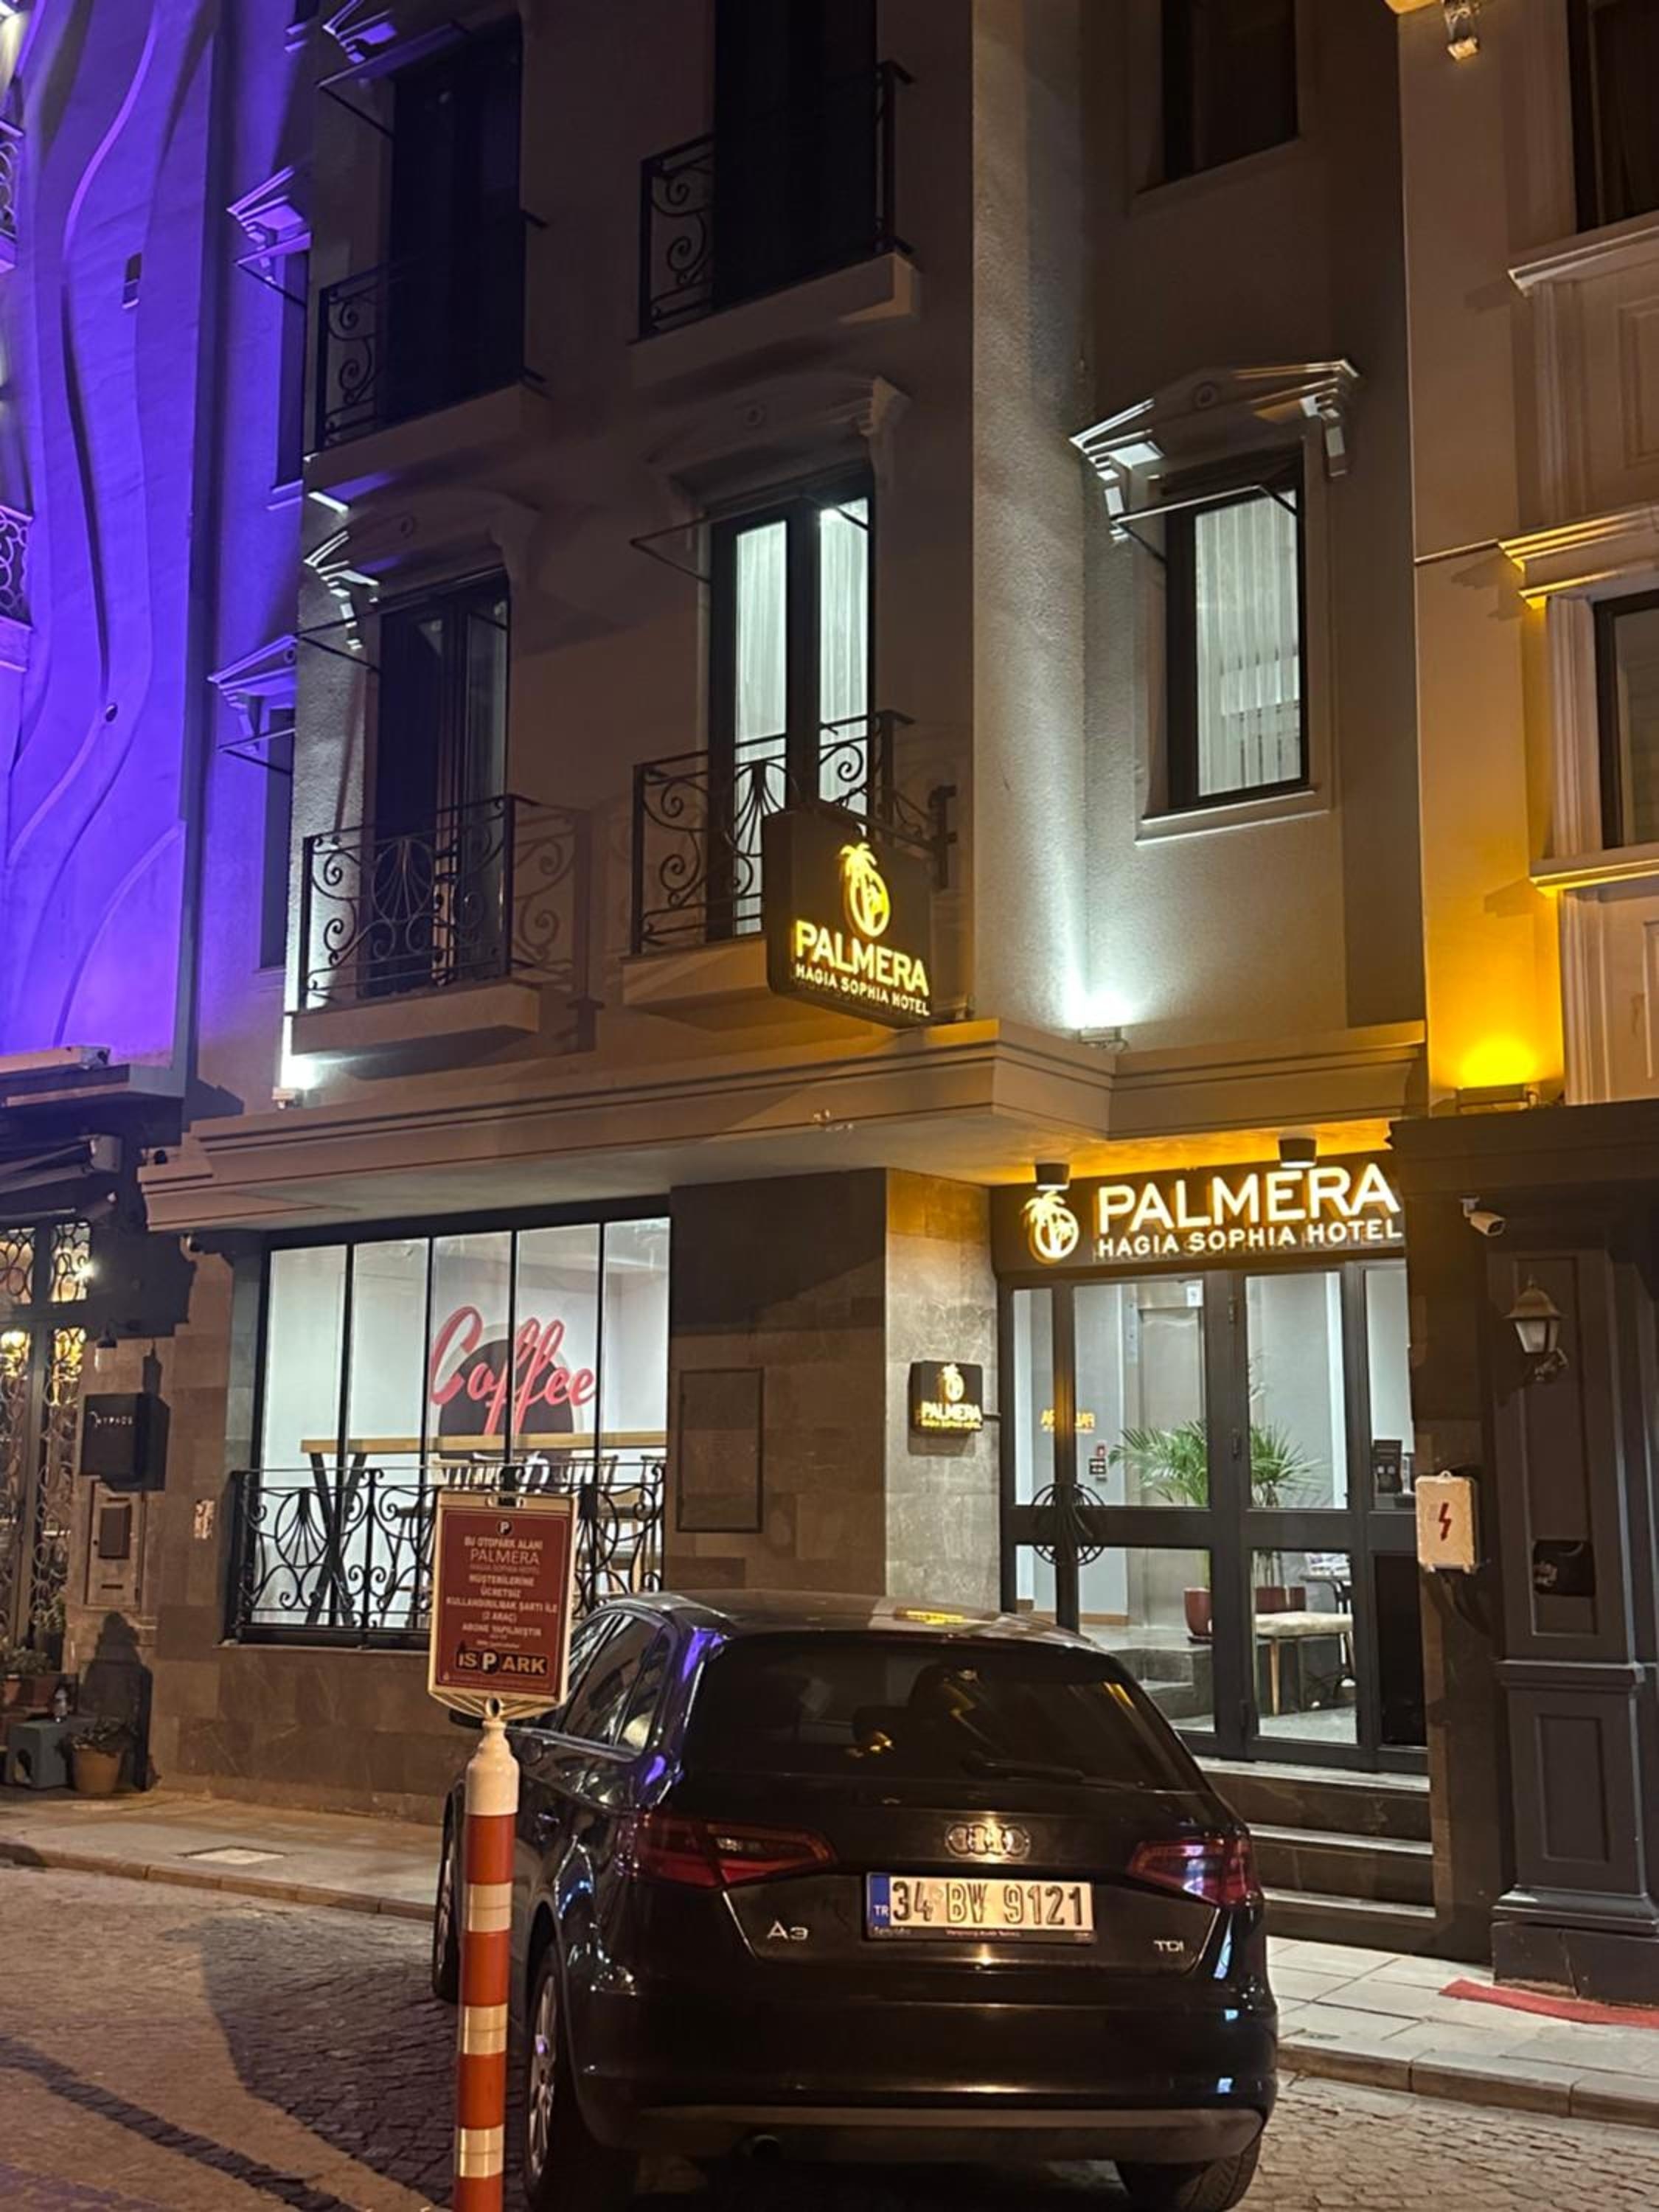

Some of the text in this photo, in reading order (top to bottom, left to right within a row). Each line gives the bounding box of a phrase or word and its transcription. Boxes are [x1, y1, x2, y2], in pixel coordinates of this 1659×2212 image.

[796, 920, 929, 996] PALMERA
[796, 963, 931, 1016] HAGIA SOPHIA HOTEL
[1098, 1163, 1401, 1235] PALMERA
[1098, 1219, 1403, 1258] HAGIA SOPHIA HOTEL
[429, 1305, 596, 1436] Coffee
[470, 1548, 540, 1565] PALMERA
[874, 1905, 889, 1917] TR
[892, 1881, 933, 1921] 34
[1004, 1885, 1082, 1926] 9121
[767, 1920, 808, 1940] A3
[1153, 1940, 1184, 1952] TDI
